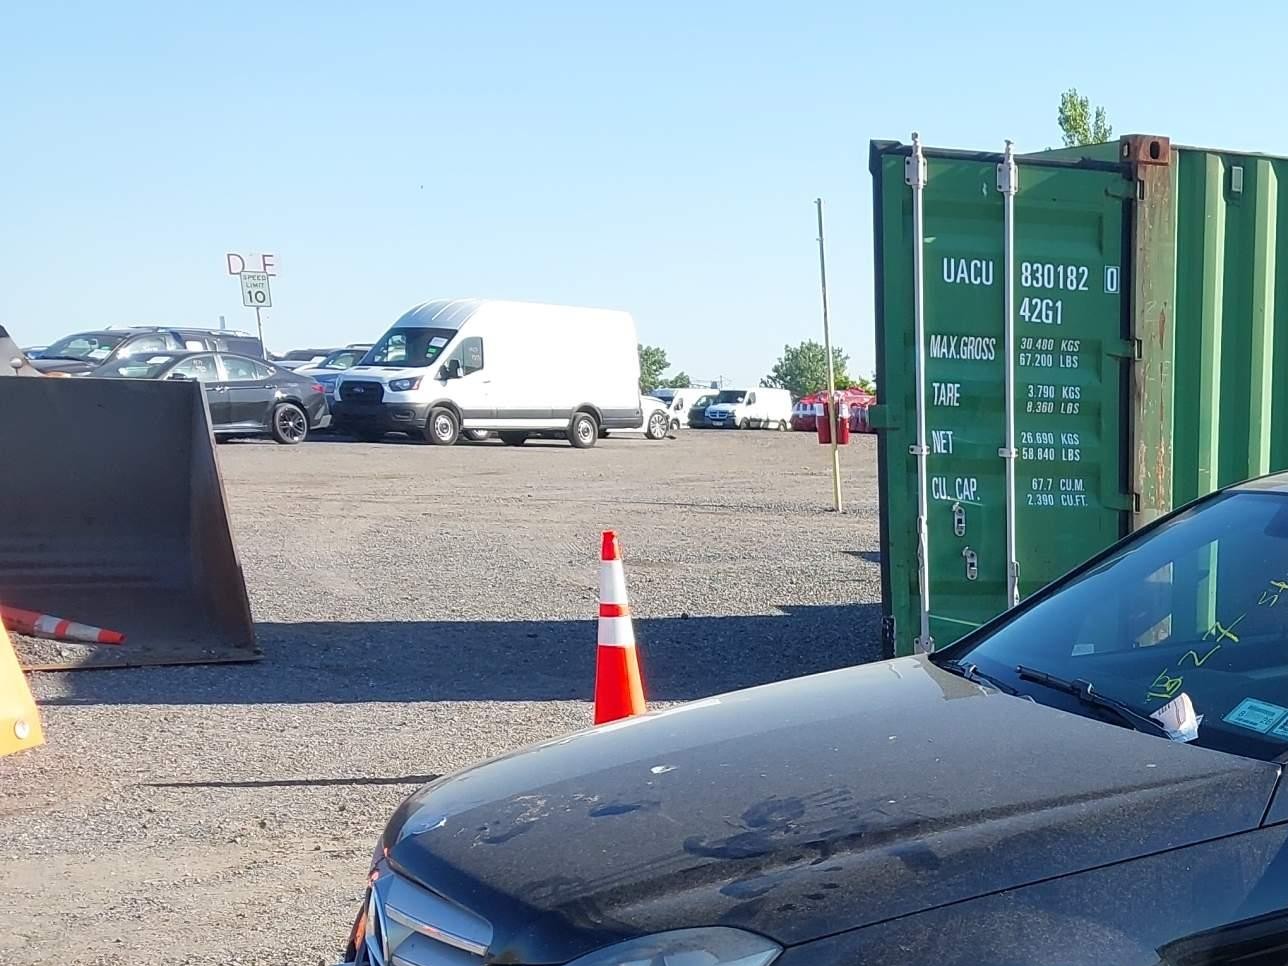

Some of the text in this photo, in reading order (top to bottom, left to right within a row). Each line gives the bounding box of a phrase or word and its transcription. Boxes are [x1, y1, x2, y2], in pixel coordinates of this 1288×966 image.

[227, 253, 245, 275] D
[943, 257, 1118, 292] UACU 830182 0
[247, 290, 266, 303] 10
[1019, 297, 1063, 324] 42G1
[930, 334, 1081, 360] MAX.GROSS 30.480 KGS
[1019, 353, 1079, 368] 67.200 LBS
[932, 383, 1081, 407] TARE 3.790 KGS
[1026, 401, 1079, 414] 8.360 LBS
[932, 430, 1080, 454] NET 26.690 KGS
[1022, 448, 1081, 461] 58.840 LBS
[932, 477, 1085, 501] CU. CAP. 67.7 CU.M.
[1027, 494, 1088, 506] 2.390 CU.FT.
